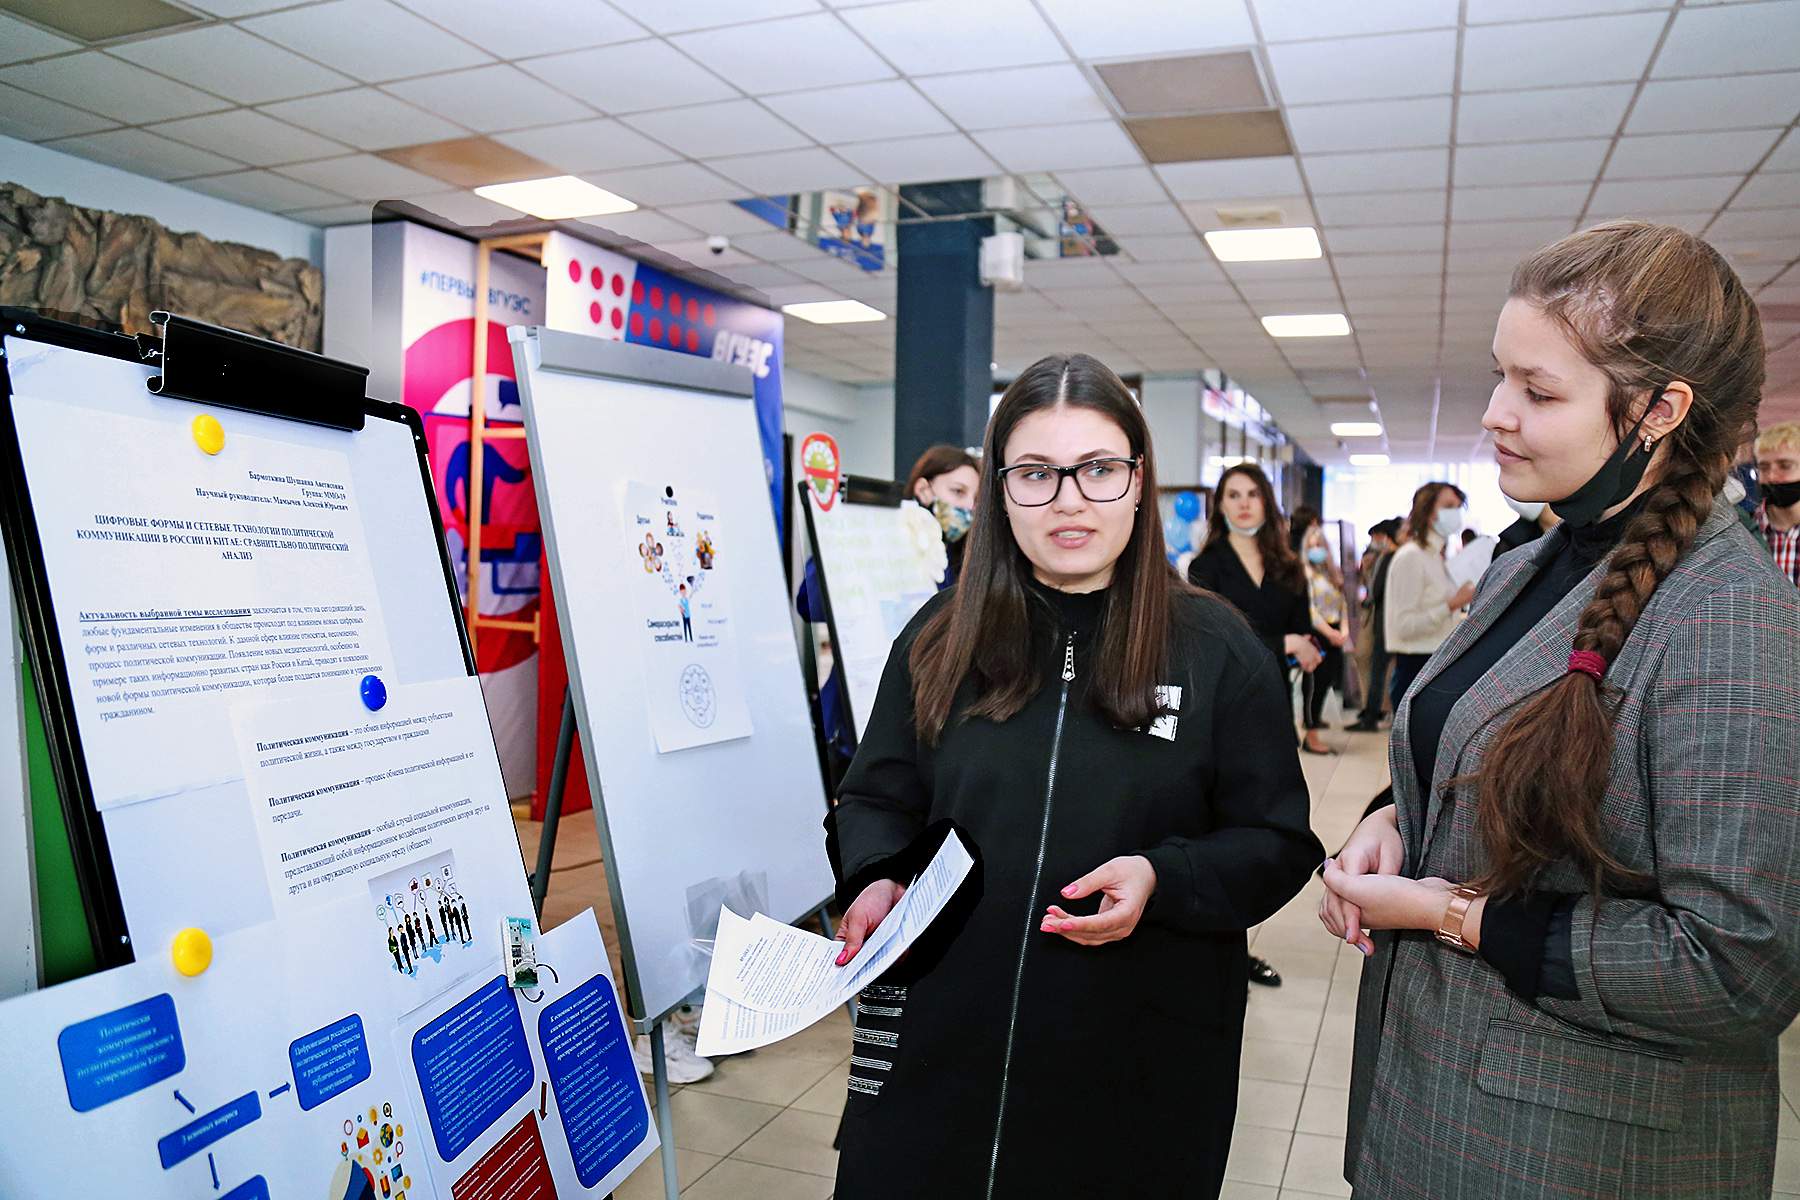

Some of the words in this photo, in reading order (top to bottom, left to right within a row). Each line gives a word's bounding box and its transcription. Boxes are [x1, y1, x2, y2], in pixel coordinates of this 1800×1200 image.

[712, 330, 773, 378] ВГУЭС
[95, 514, 148, 527] ЦИФРОВЫЕ
[150, 518, 184, 530] ФОРМЫ
[186, 521, 192, 530] И
[194, 522, 232, 532] СЕТЕВЫЕ
[233, 524, 280, 536] ТЕХНОЛОГИИ
[281, 528, 334, 539] ПОЛИТИЧЕСКОЙ
[76, 529, 160, 543] КОММУНИКАЦИИ
[162, 534, 169, 543] В
[169, 535, 204, 545] РОССИИ
[206, 536, 212, 545] И
[212, 537, 242, 546] КИТАЕ:
[244, 538, 297, 550] СРАВНИТЕЛЬНО
[298, 542, 350, 552] ПОЛИТИЧЕСКИЙ
[222, 551, 252, 560] АНАЛИЗ
[256, 737, 304, 752] Политическая
[304, 729, 349, 743] коммуникация
[268, 790, 315, 807] Политическая
[316, 780, 360, 794] коммуникация
[280, 842, 327, 862] Политическая
[327, 828, 372, 845] коммуникация
